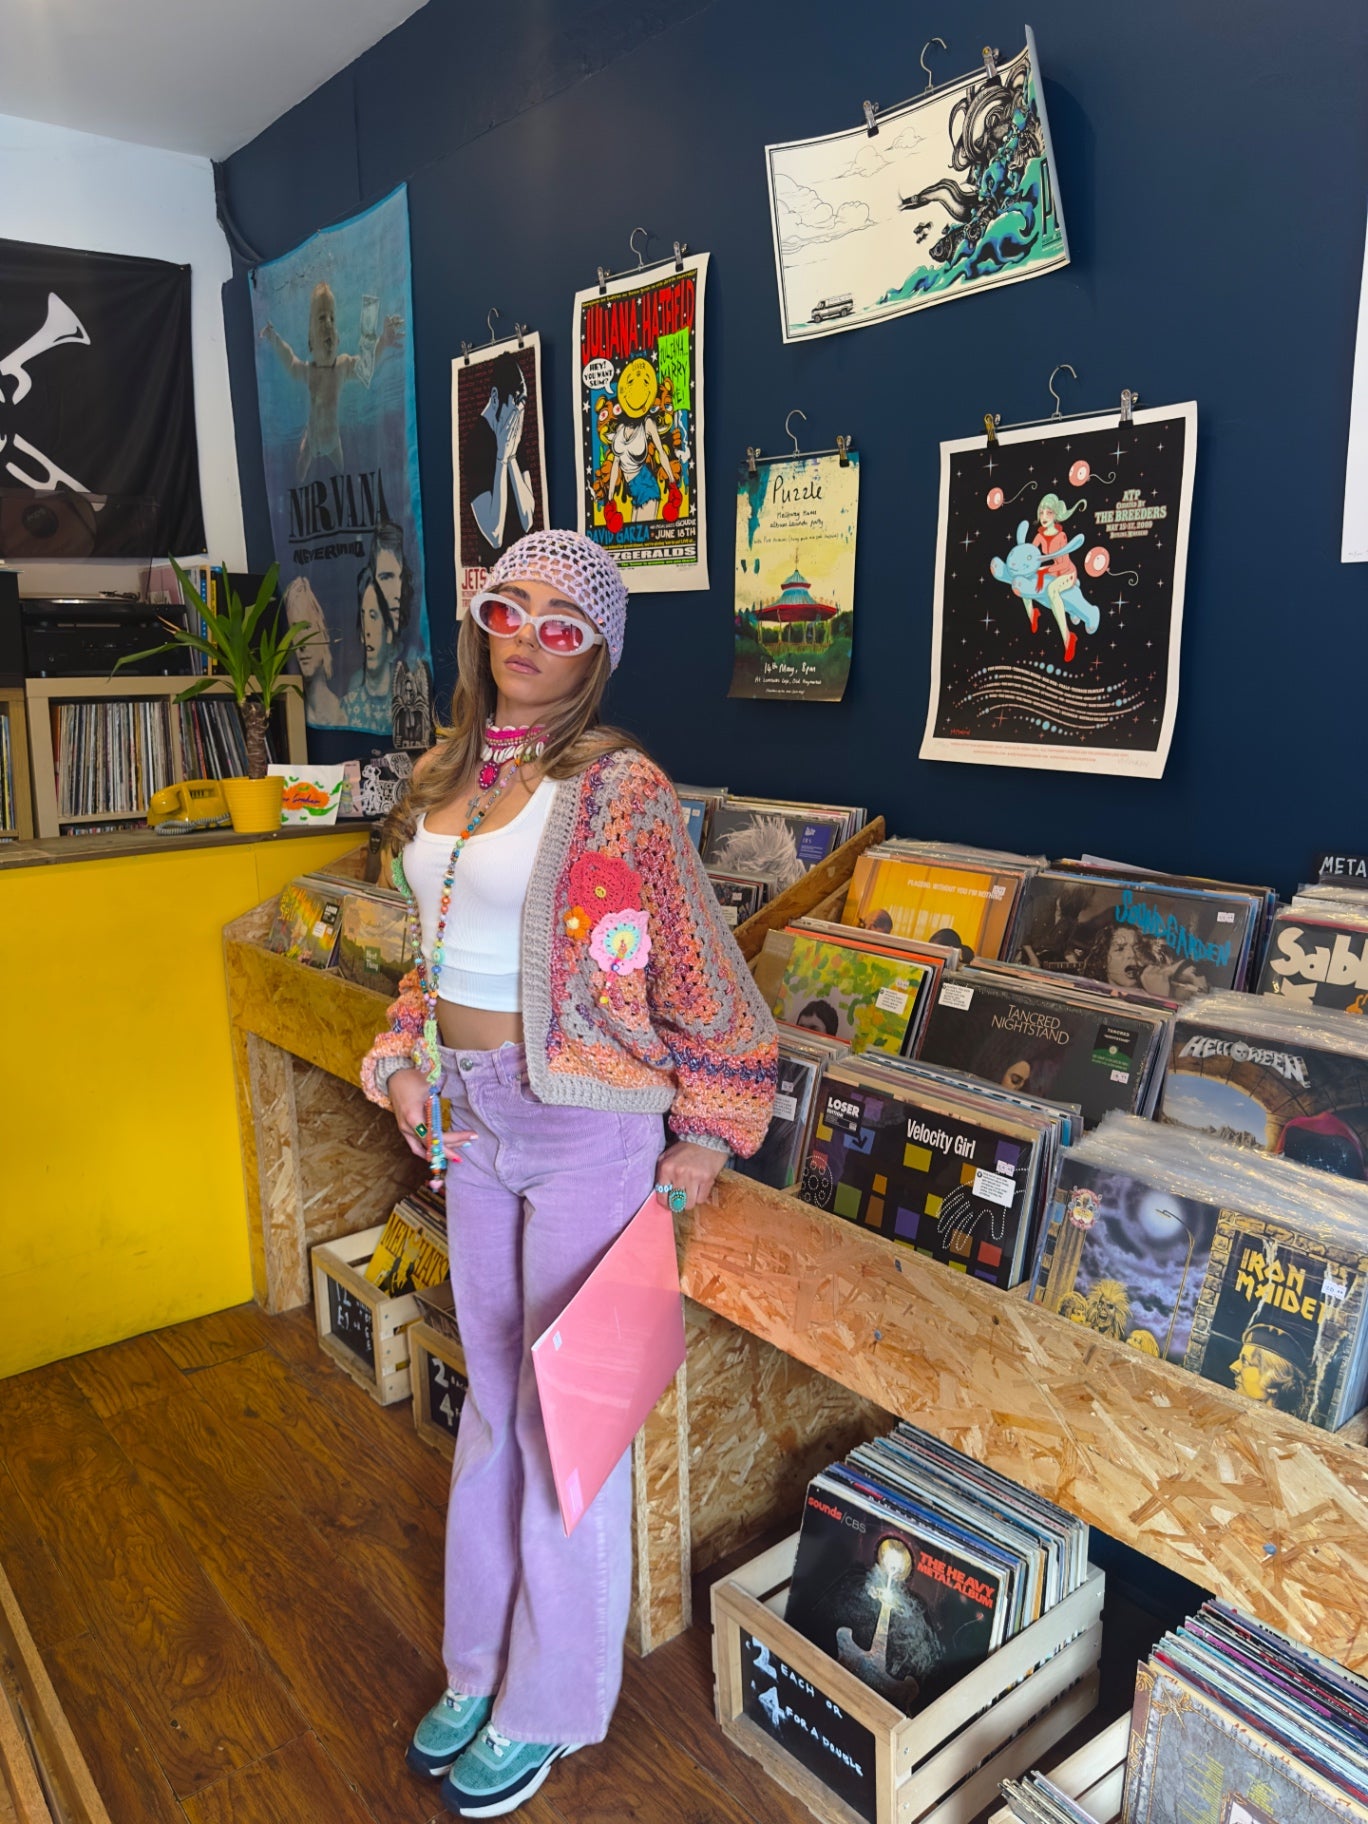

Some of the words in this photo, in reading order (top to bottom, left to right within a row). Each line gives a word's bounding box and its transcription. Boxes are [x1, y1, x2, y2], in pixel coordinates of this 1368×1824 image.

[582, 298, 638, 366] JULIANA
[643, 279, 694, 349] HATFIELD
[288, 468, 391, 537] NIRVANA
[773, 475, 822, 504] Puzzle
[1122, 489, 1141, 501] ATP
[1095, 510, 1114, 524] THE
[1115, 505, 1167, 522] BREEDERS
[616, 525, 649, 544] GARZA
[655, 529, 675, 540] JUNE
[611, 547, 696, 561] ZGERALDS
[462, 568, 486, 590] JETS
[992, 1014, 1070, 1045] NIGHTSTAND
[1008, 1004, 1060, 1030] TANCRED
[828, 1096, 860, 1118] LOSER
[907, 1118, 953, 1154] Velocity
[954, 1135, 976, 1159] Girl
[1240, 1248, 1306, 1296] IRON
[917, 1564, 950, 1588] METAL
[950, 1582, 993, 1608] ALBUM
[920, 1552, 946, 1572] THE
[948, 1565, 994, 1598] HEAVY
[780, 1663, 814, 1698] EACH
[826, 1700, 842, 1718] OR
[786, 1705, 808, 1732] FOR
[810, 1726, 820, 1740] A
[822, 1735, 864, 1777] DOUBLE
